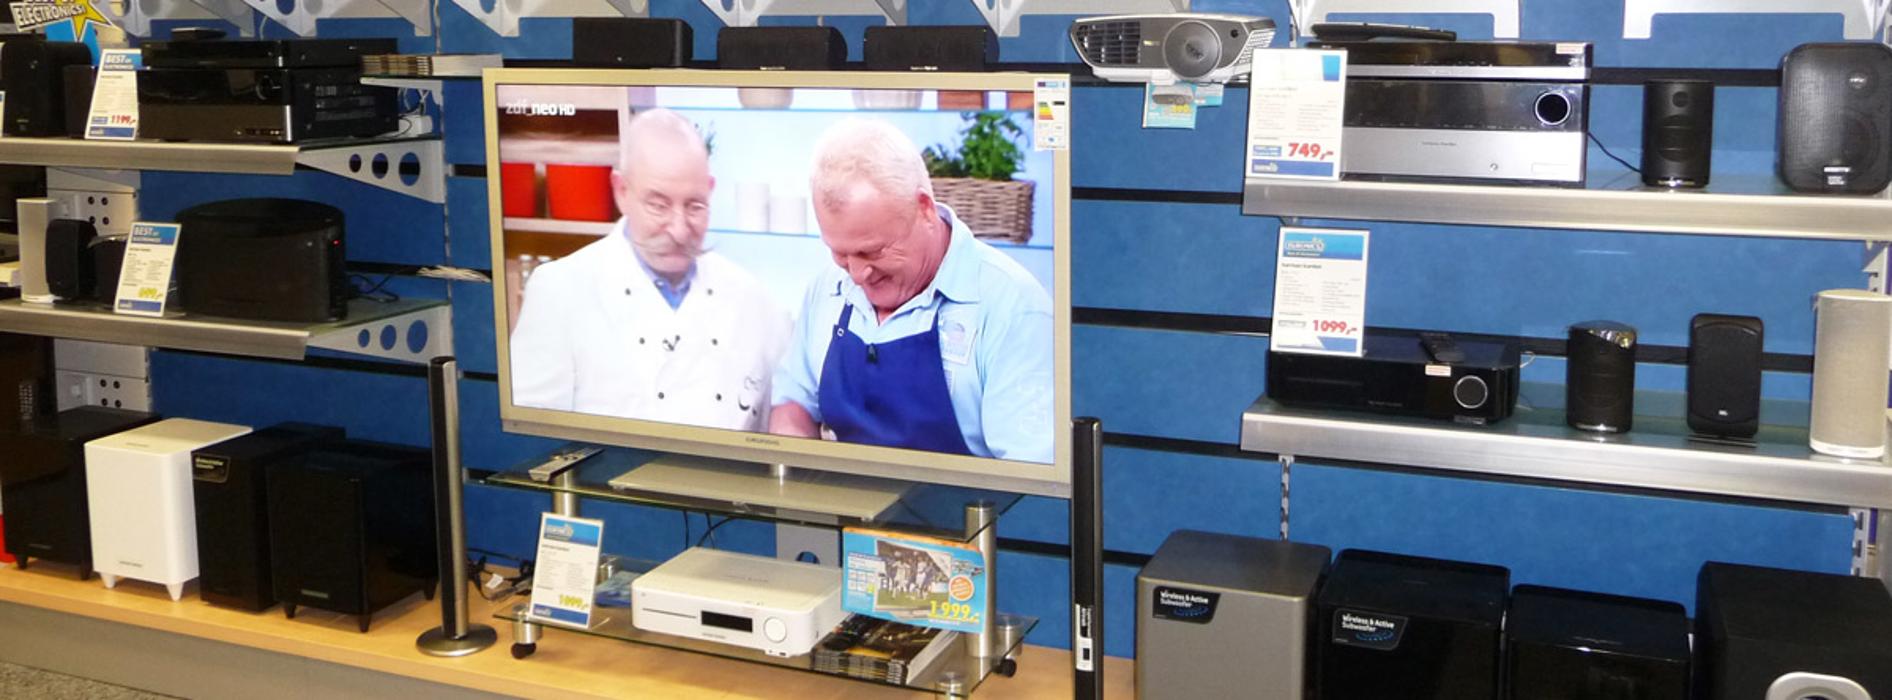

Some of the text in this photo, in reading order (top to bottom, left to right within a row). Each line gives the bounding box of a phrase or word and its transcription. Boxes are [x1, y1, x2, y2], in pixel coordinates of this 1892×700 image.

[558, 103, 577, 117] HD
[1288, 142, 1334, 161] 749,-
[1313, 319, 1358, 335] 1099,-
[1160, 590, 1185, 600] Wireless
[1190, 595, 1209, 604] Active
[1342, 613, 1369, 625] Wireless
[1375, 619, 1395, 629] Active
